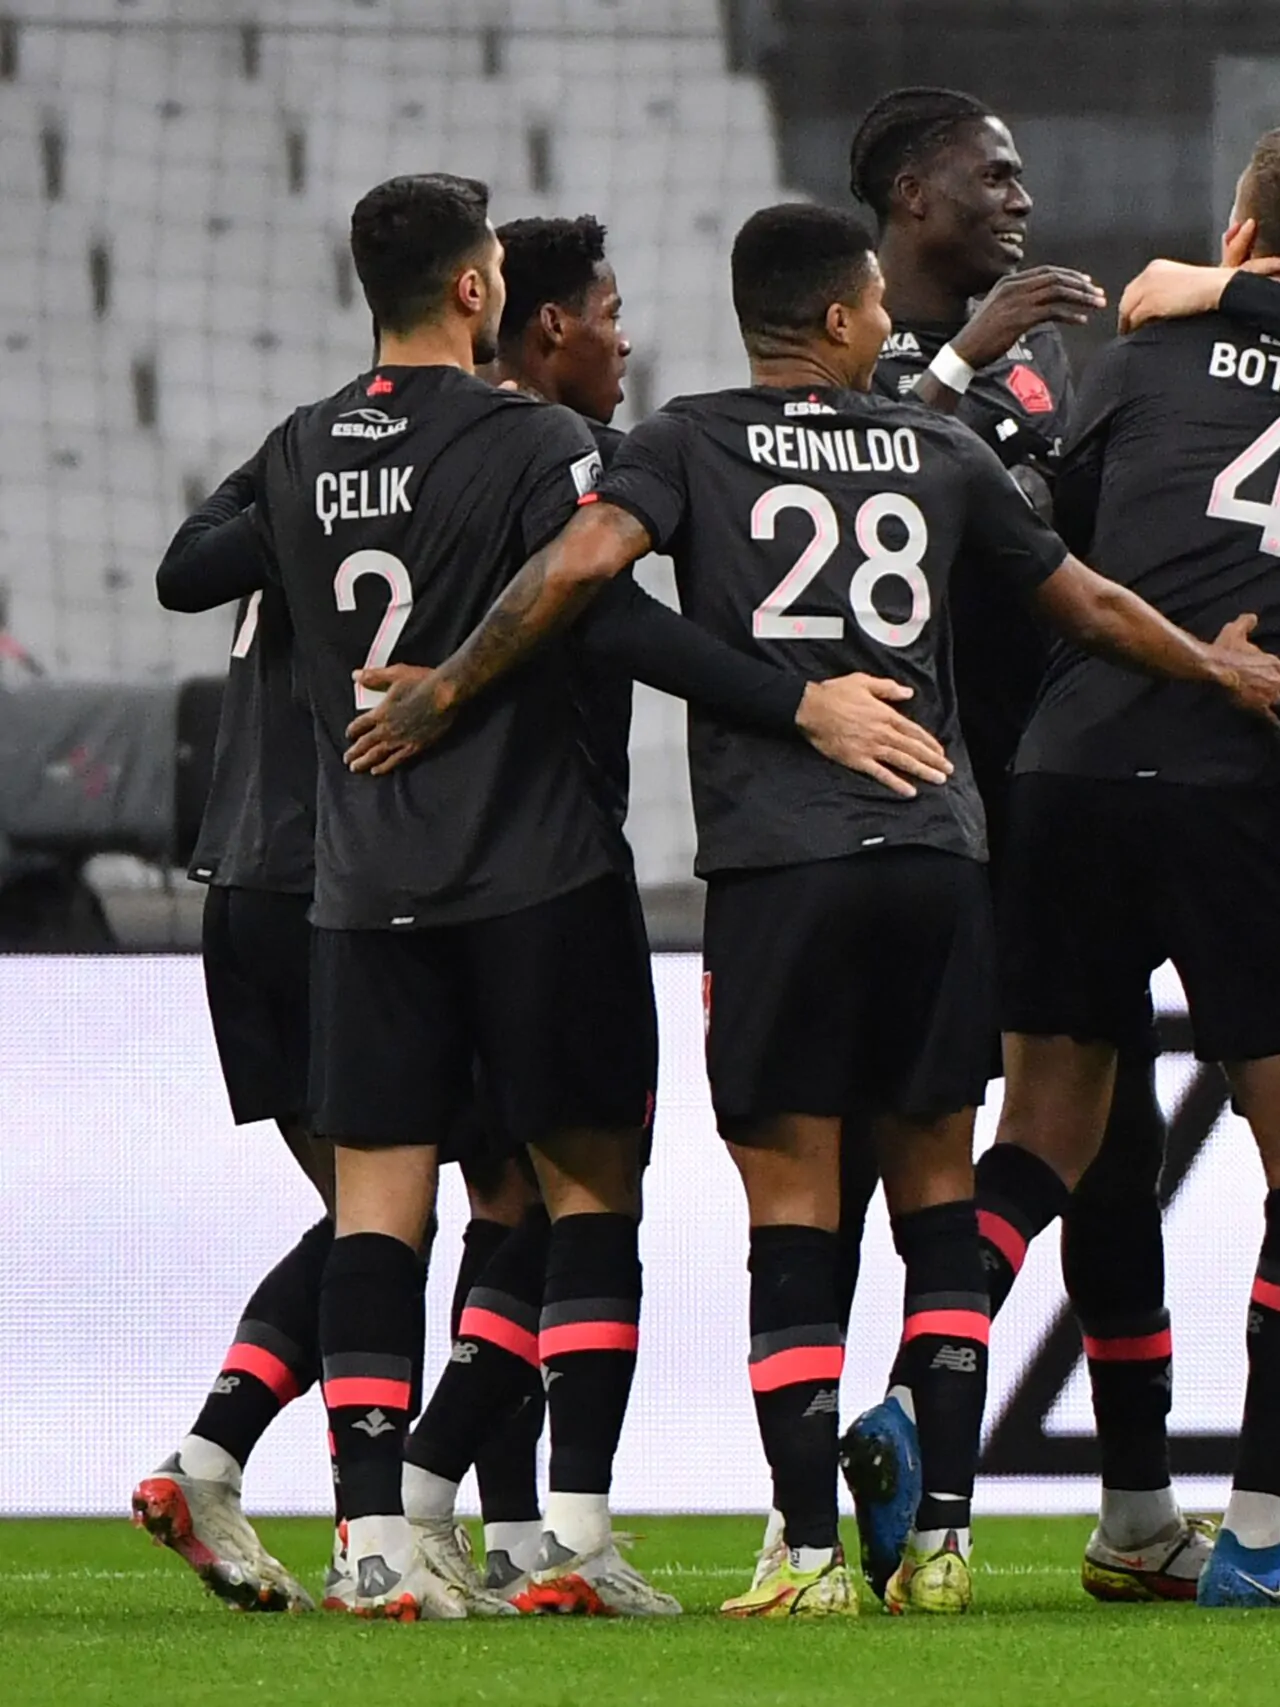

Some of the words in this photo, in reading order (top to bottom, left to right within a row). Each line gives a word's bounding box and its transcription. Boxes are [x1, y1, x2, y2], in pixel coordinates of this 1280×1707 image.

[316, 466, 412, 535] ÇELIK
[747, 424, 920, 474] REINILDO
[751, 484, 931, 647] 28
[334, 549, 412, 710] 2
